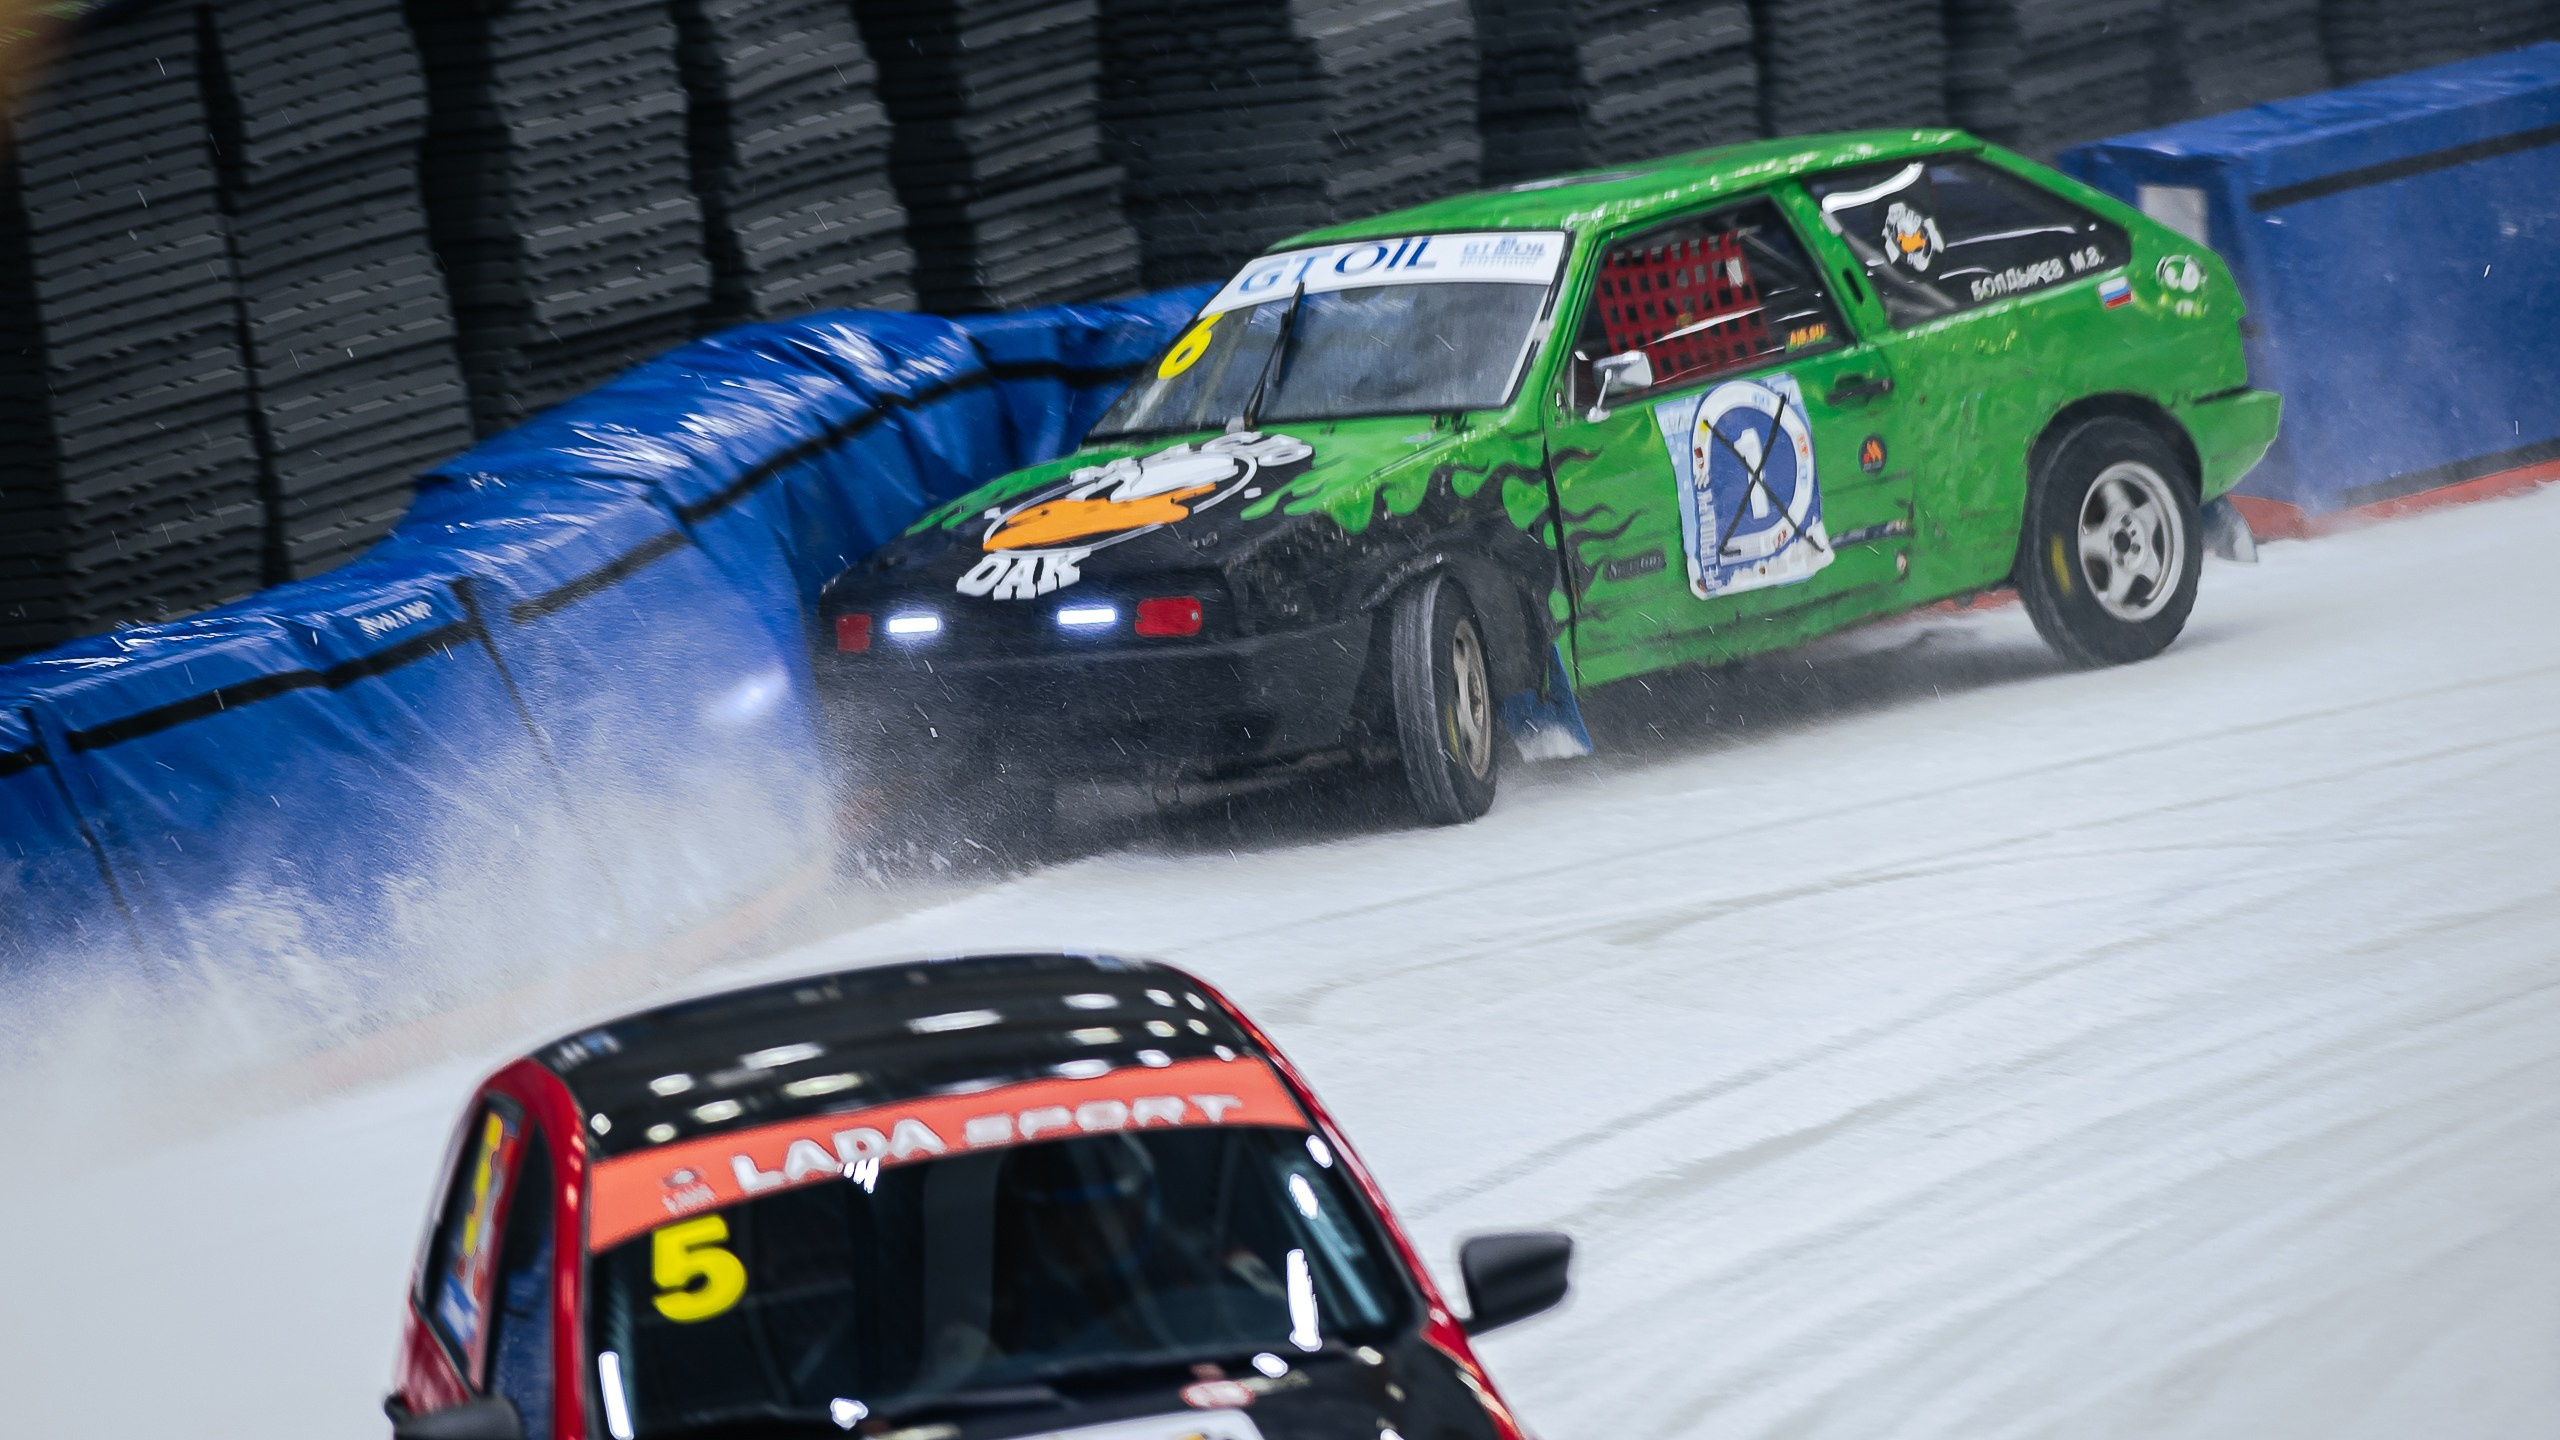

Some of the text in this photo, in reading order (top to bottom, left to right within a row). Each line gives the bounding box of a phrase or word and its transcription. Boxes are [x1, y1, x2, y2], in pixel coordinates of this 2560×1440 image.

[1239, 237, 1437, 294] GT OIL
[1158, 311, 1226, 380] 6
[731, 1094, 1243, 1195] LADA SPORT
[651, 1213, 748, 1323] 5
